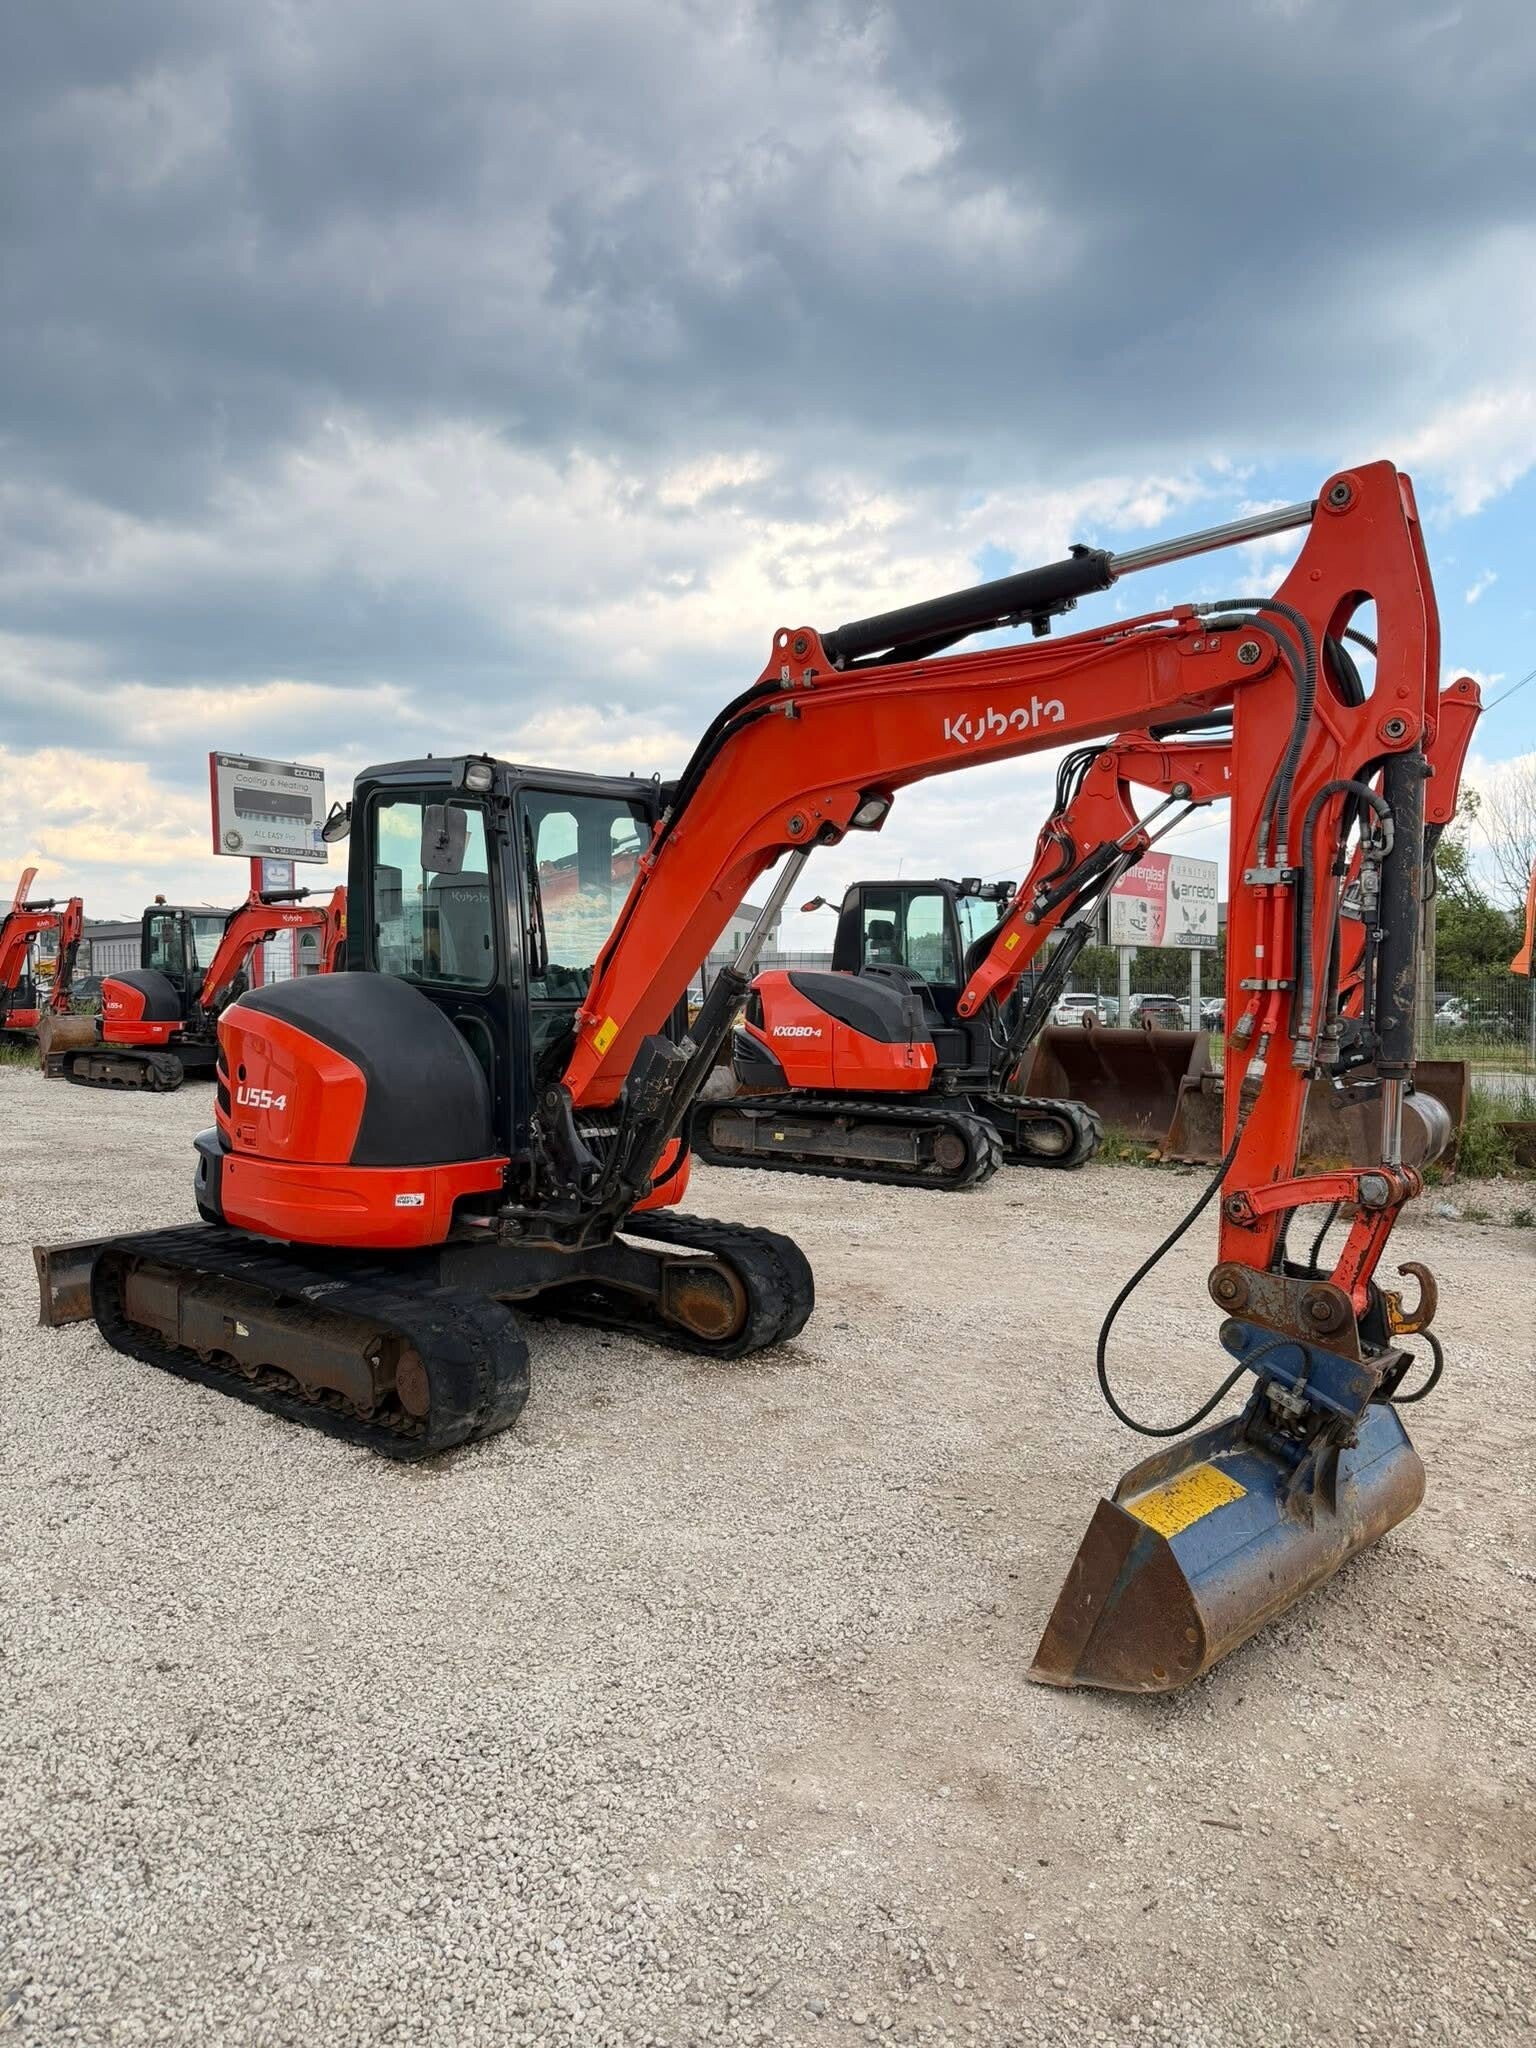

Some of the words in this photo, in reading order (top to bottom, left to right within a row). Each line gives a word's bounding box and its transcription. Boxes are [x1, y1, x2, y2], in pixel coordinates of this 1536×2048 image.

[944, 695, 1065, 744] Kubota
[294, 769, 321, 780] ECOLUX
[236, 773, 267, 787] Cooling
[270, 778, 276, 787] &
[278, 780, 309, 792] Heating
[254, 830, 266, 839] ALL
[267, 831, 284, 840] EASY
[451, 891, 489, 903] Kubota
[1181, 883, 1215, 900] arredo
[773, 1026, 822, 1037] KX080-4
[237, 1086, 287, 1111] U55-4
